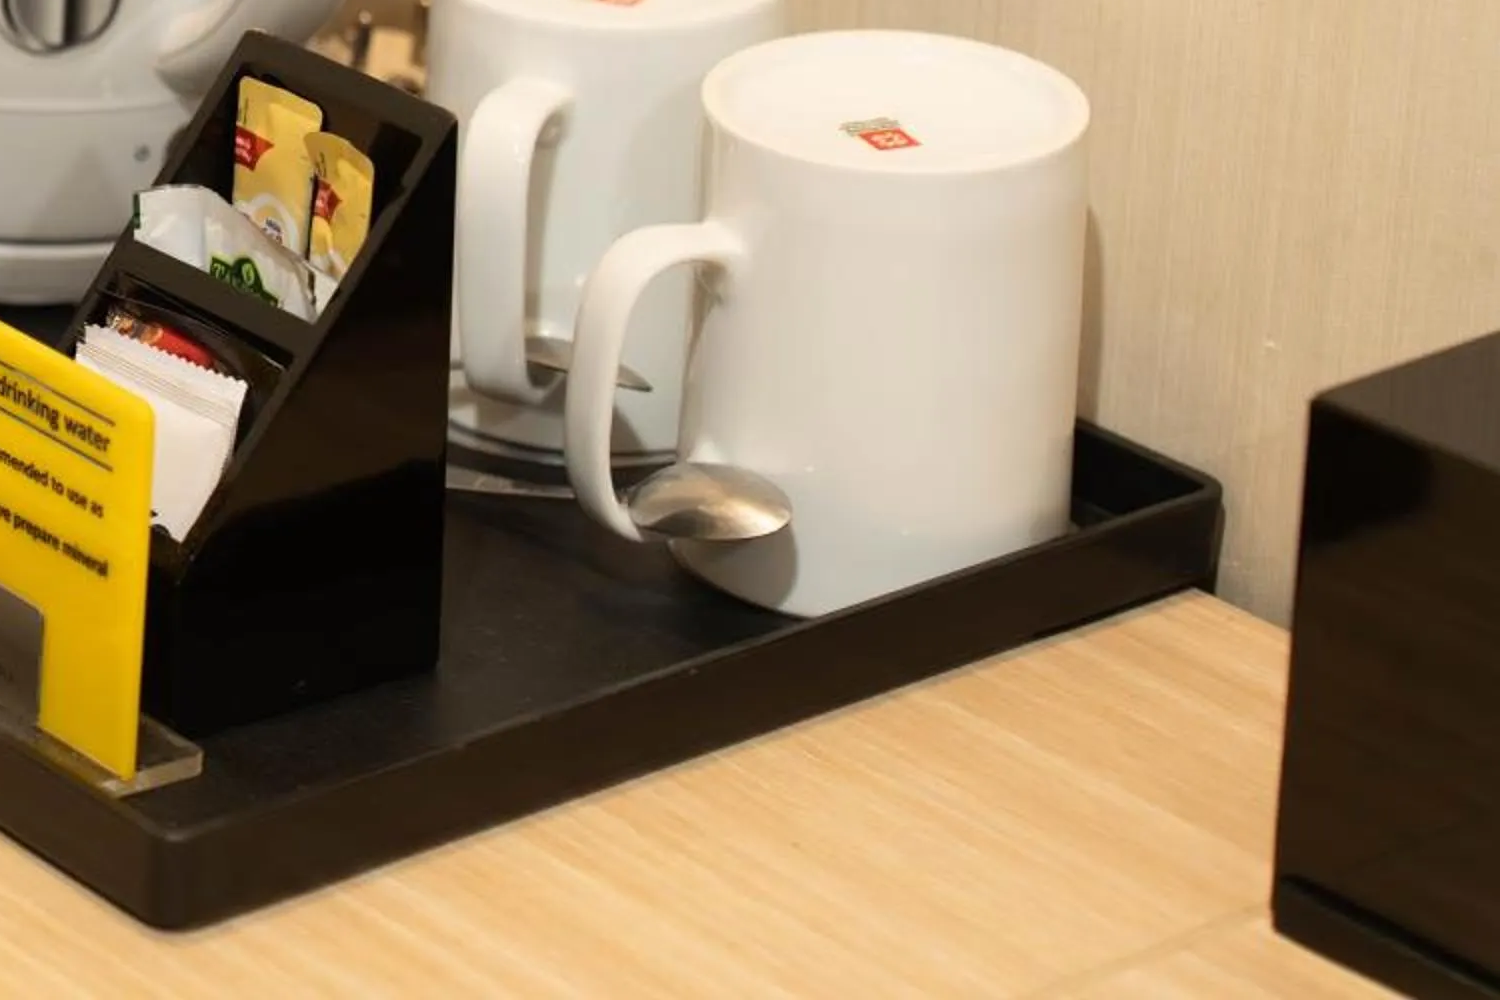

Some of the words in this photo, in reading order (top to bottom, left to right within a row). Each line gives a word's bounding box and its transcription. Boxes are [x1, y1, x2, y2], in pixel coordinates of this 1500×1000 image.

[63, 414, 111, 453] water
[50, 475, 65, 496] to
[66, 487, 88, 511] use
[89, 499, 105, 519] as
[12, 513, 61, 551] prepare
[61, 539, 109, 578] mineral
